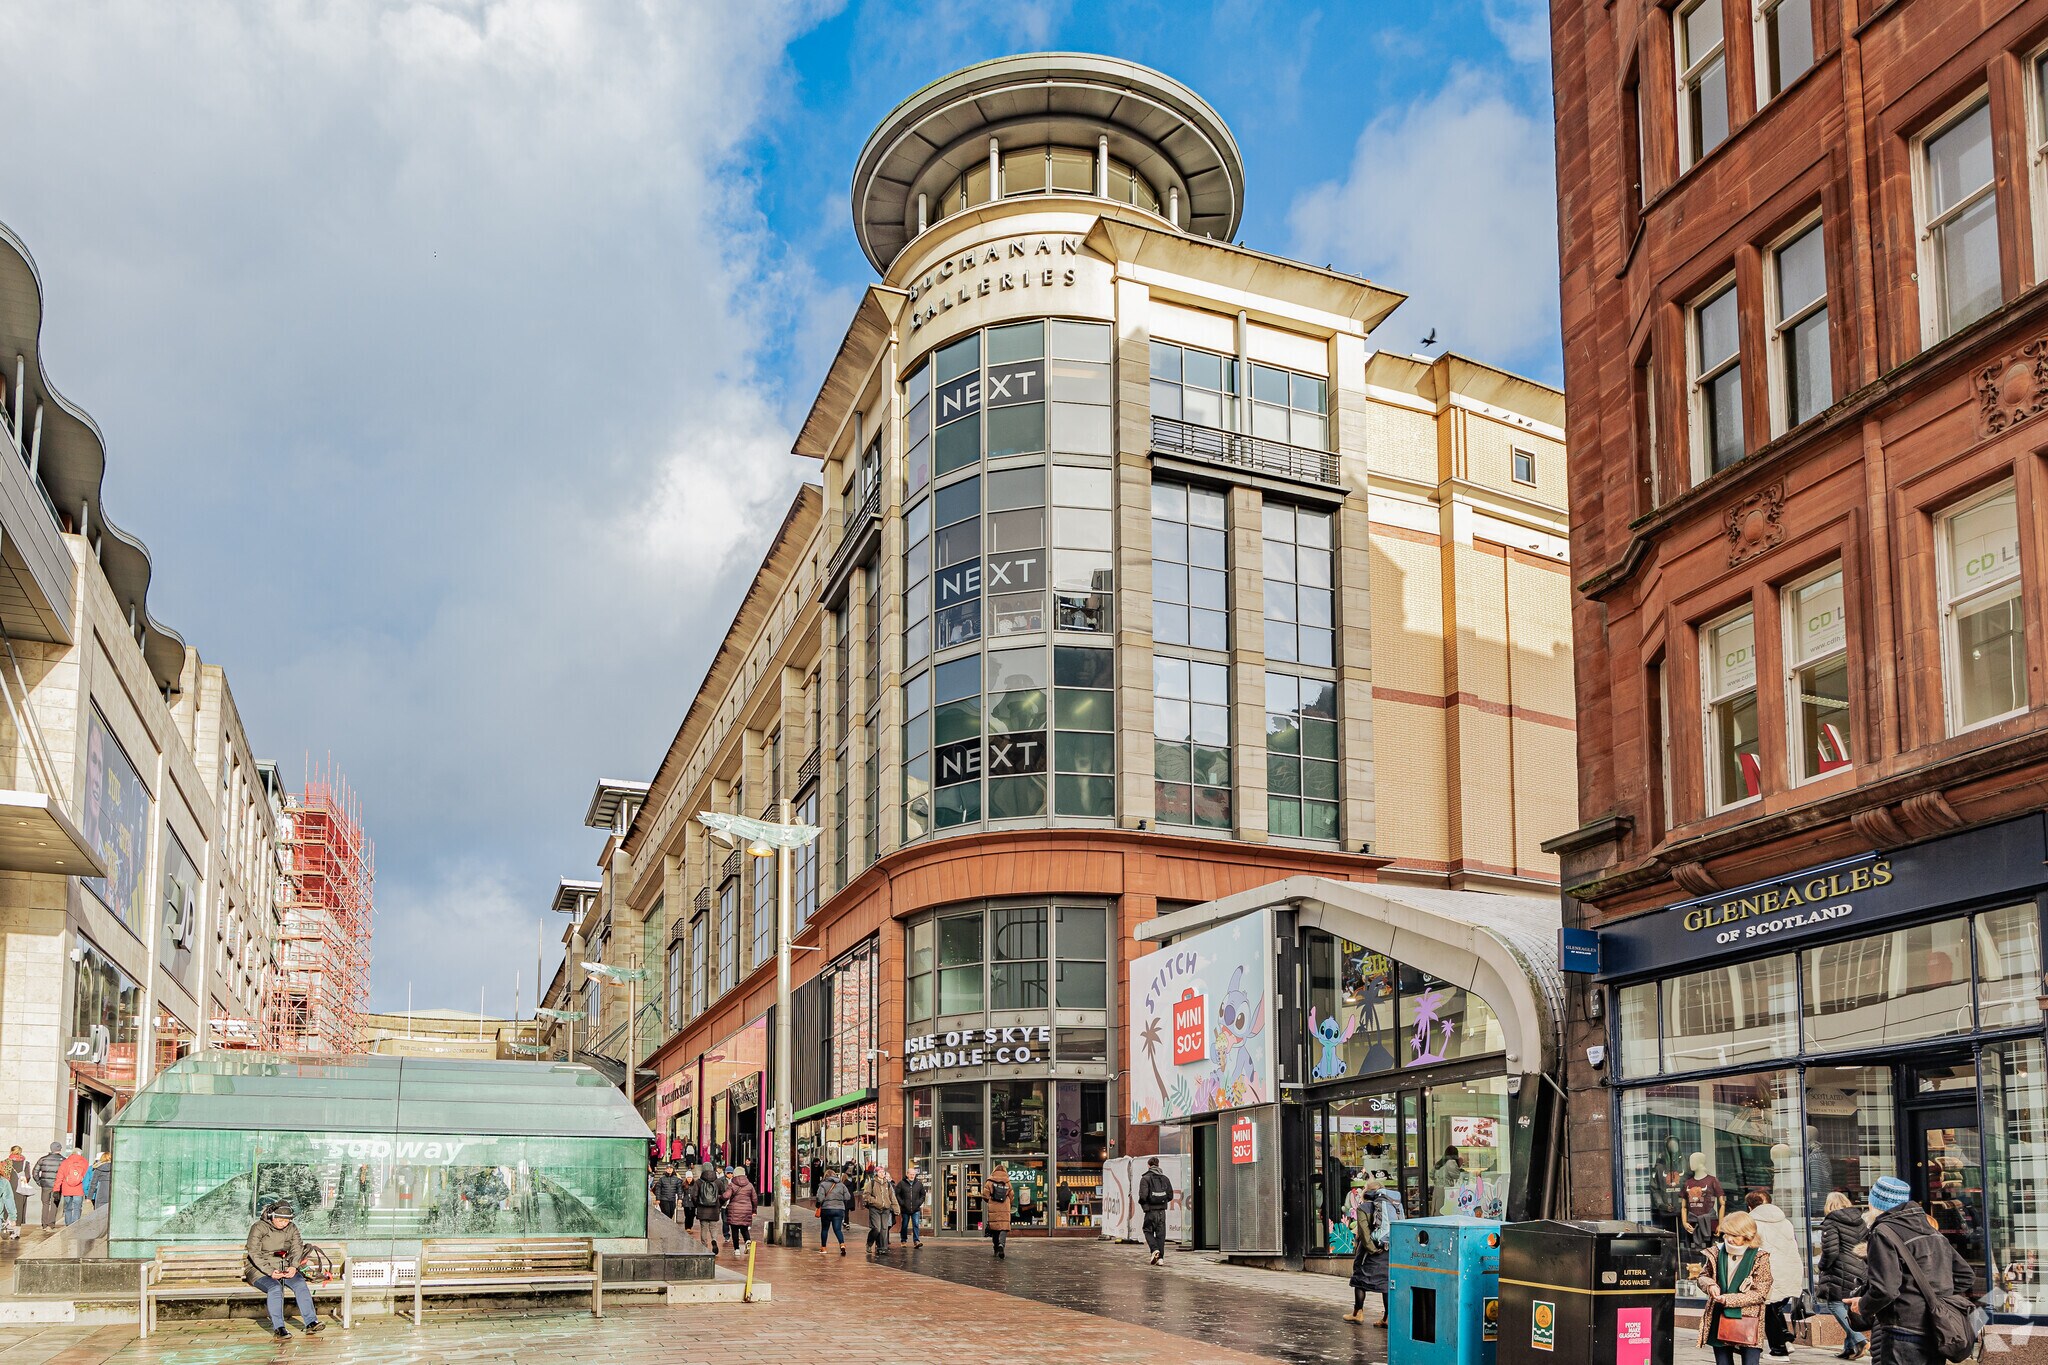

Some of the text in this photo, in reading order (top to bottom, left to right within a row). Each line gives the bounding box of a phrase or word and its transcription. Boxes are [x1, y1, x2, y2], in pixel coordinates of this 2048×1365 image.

[909, 236, 1078, 302] BUCHANAN
[911, 268, 1077, 330] GALLERIES
[943, 371, 1037, 417] NEXT
[1966, 553, 1995, 576] CD
[943, 558, 1037, 600] NEXT
[1808, 611, 1832, 632] CD
[1725, 649, 1747, 668] CD
[943, 741, 1038, 779] NEXT
[1683, 861, 1894, 932] GLENEAGLES
[1716, 904, 1853, 944] OF SCOTLAND
[1145, 952, 1198, 1014] STITCH
[1176, 1005, 1202, 1031] MINI
[67, 1042, 90, 1055] JD
[905, 1026, 1051, 1054] ISLE OF SKYE
[909, 1047, 1041, 1072] CANDLE CO.
[1233, 1130, 1251, 1143] MINI
[328, 1139, 464, 1165] subway
